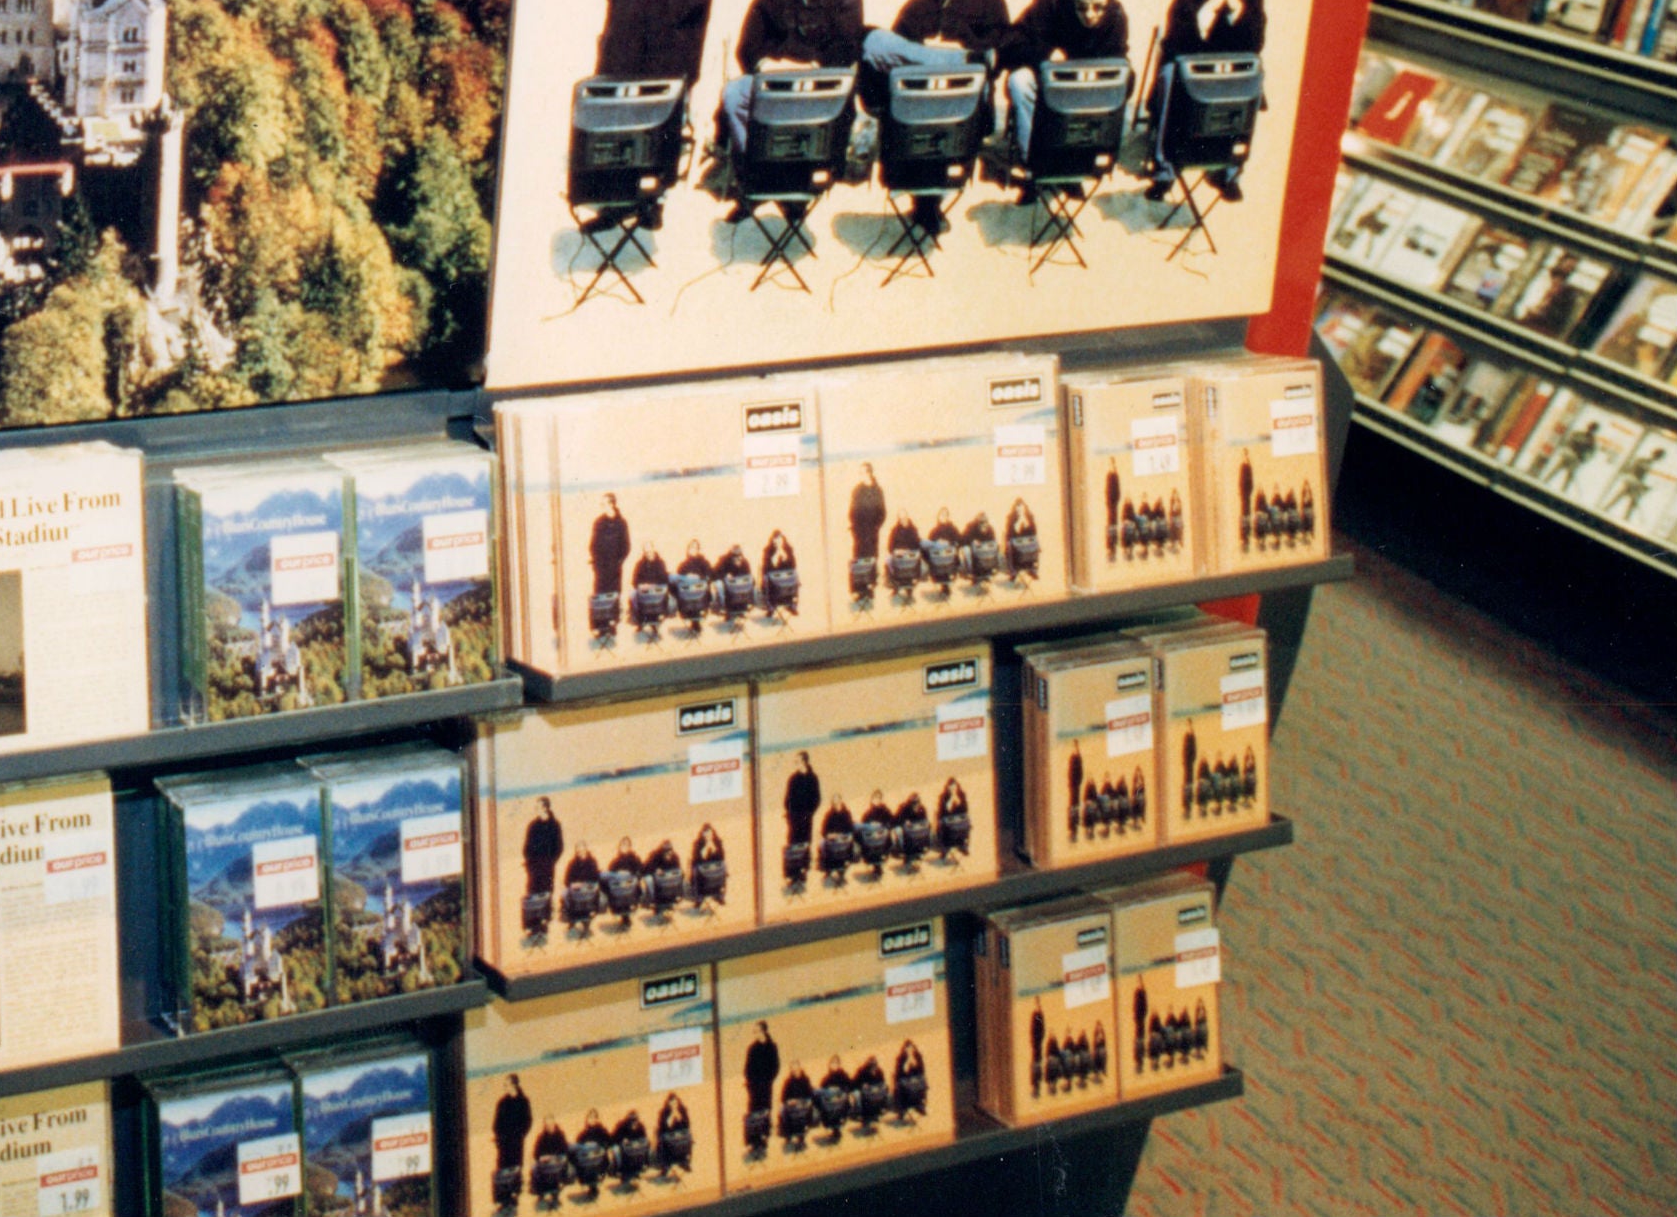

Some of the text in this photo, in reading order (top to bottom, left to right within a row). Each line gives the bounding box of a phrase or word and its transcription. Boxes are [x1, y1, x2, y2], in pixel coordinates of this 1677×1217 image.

[992, 380, 1039, 402] oasis
[747, 405, 801, 430] oasis
[12, 496, 58, 517] Live
[63, 491, 122, 512] From
[928, 664, 974, 685] oasis
[681, 705, 732, 728] oasis
[34, 811, 92, 834] From
[882, 927, 928, 951] oasis
[645, 977, 695, 1001] oasis
[33, 1107, 87, 1130] From
[60, 1188, 90, 1213] 1.99
